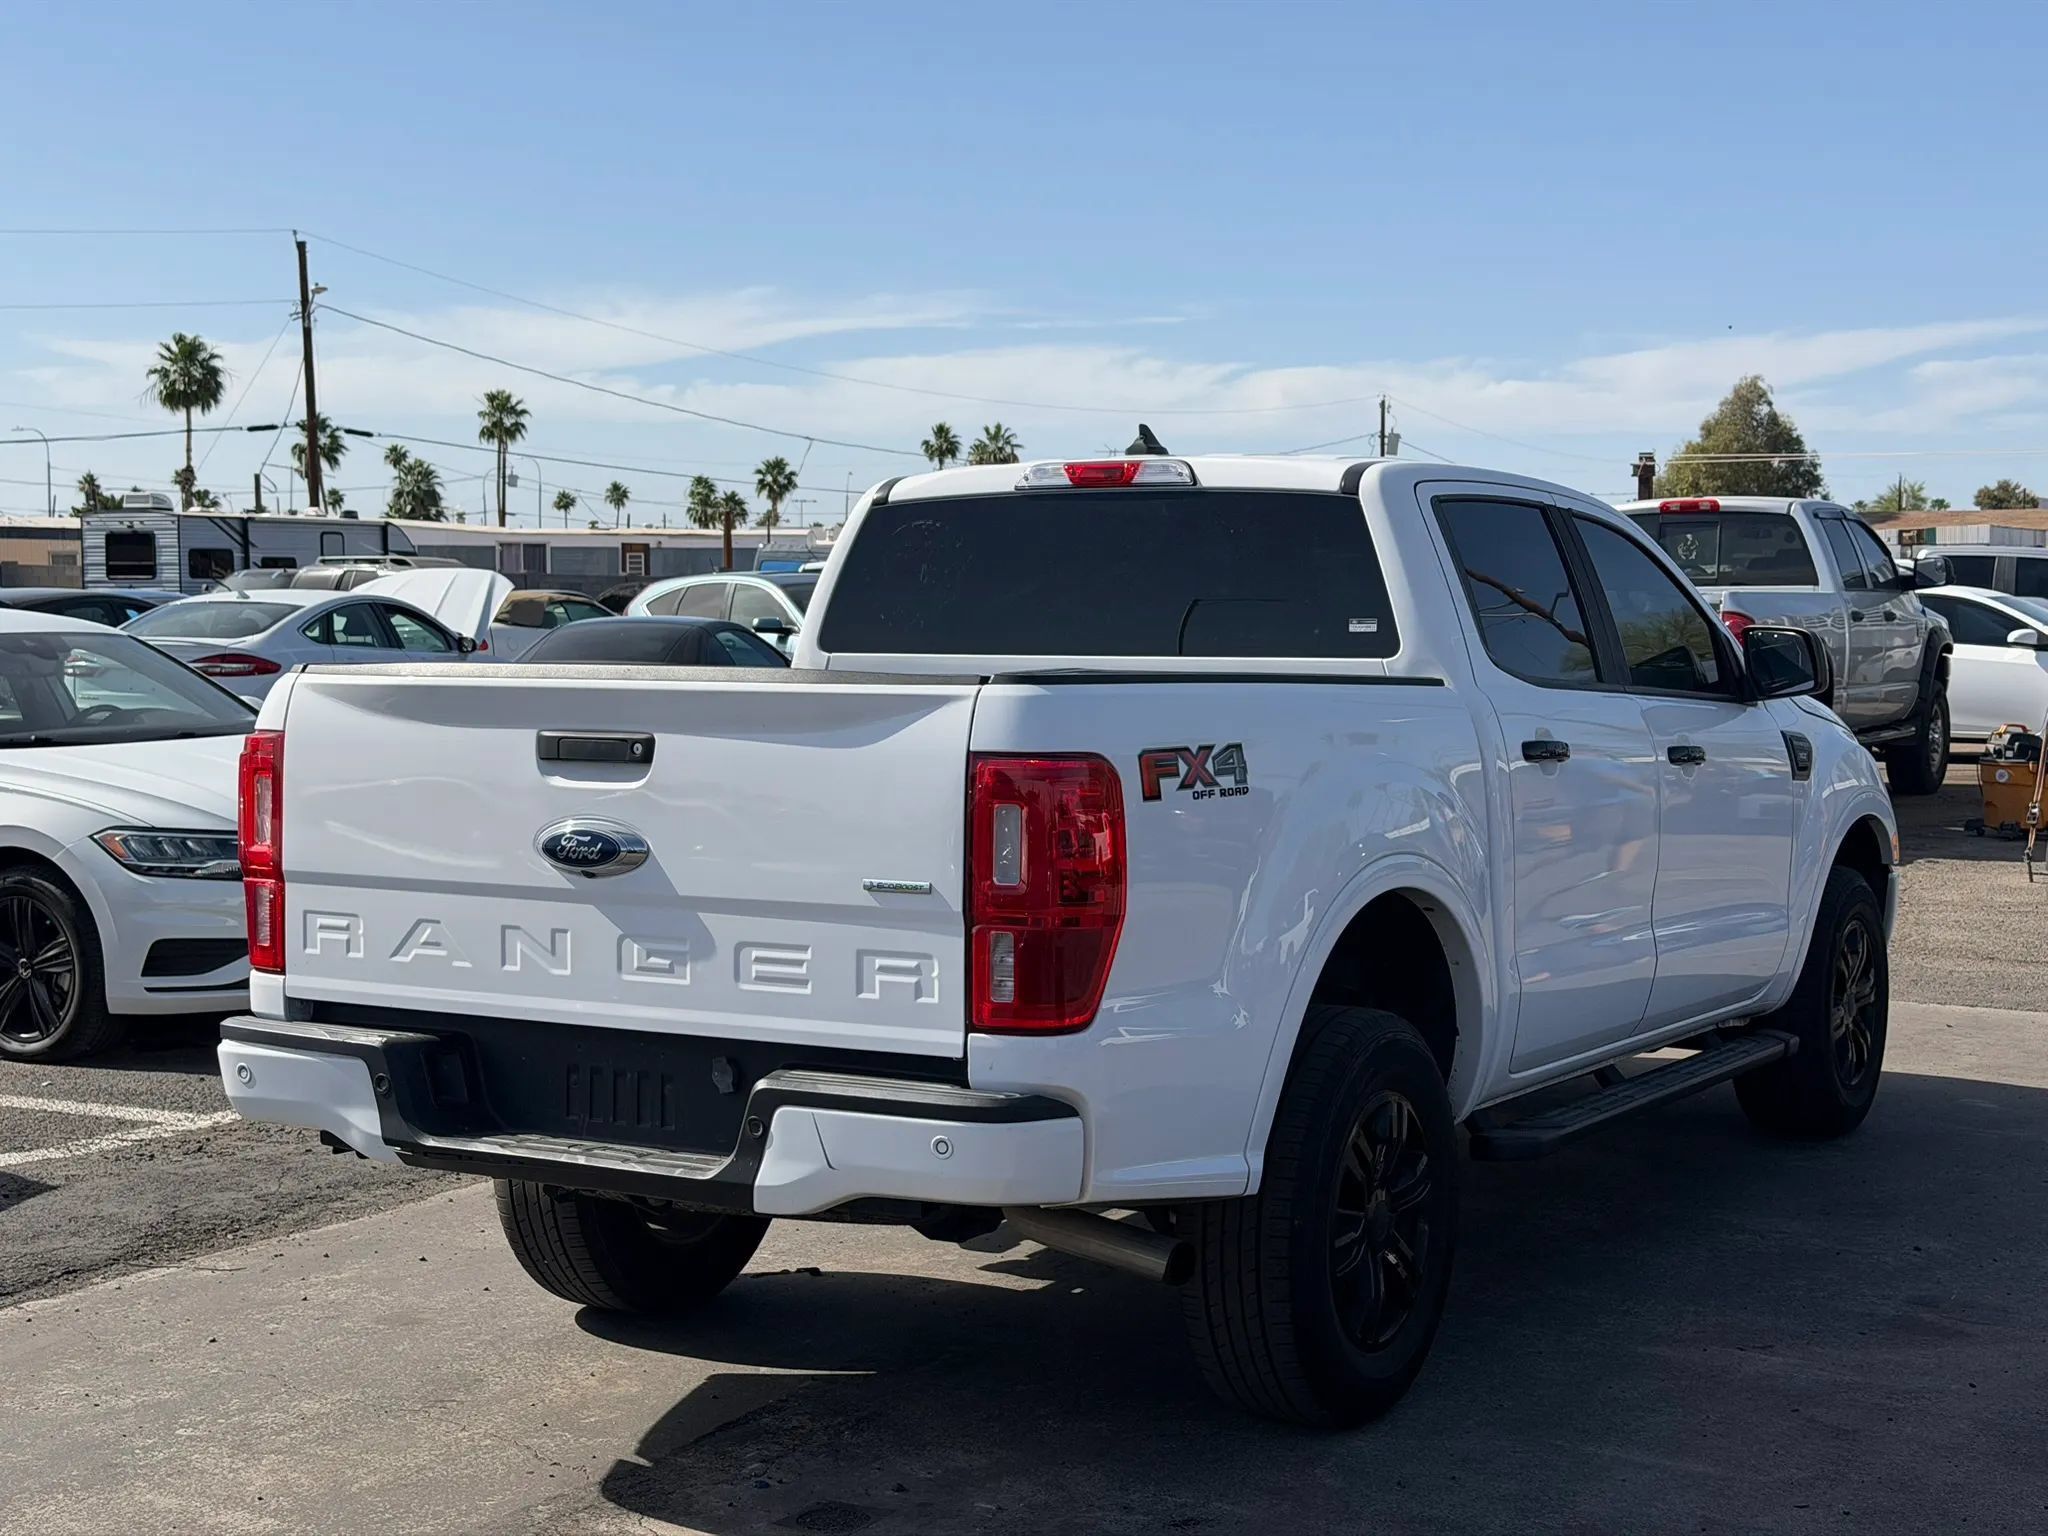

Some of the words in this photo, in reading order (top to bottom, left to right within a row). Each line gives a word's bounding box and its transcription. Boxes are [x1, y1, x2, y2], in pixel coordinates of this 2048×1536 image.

[1138, 742, 1248, 802] FX4
[1192, 790, 1215, 800] OFF
[1219, 786, 1249, 798] ROAD
[556, 834, 602, 860] Ford
[303, 910, 940, 1003] RANGER
